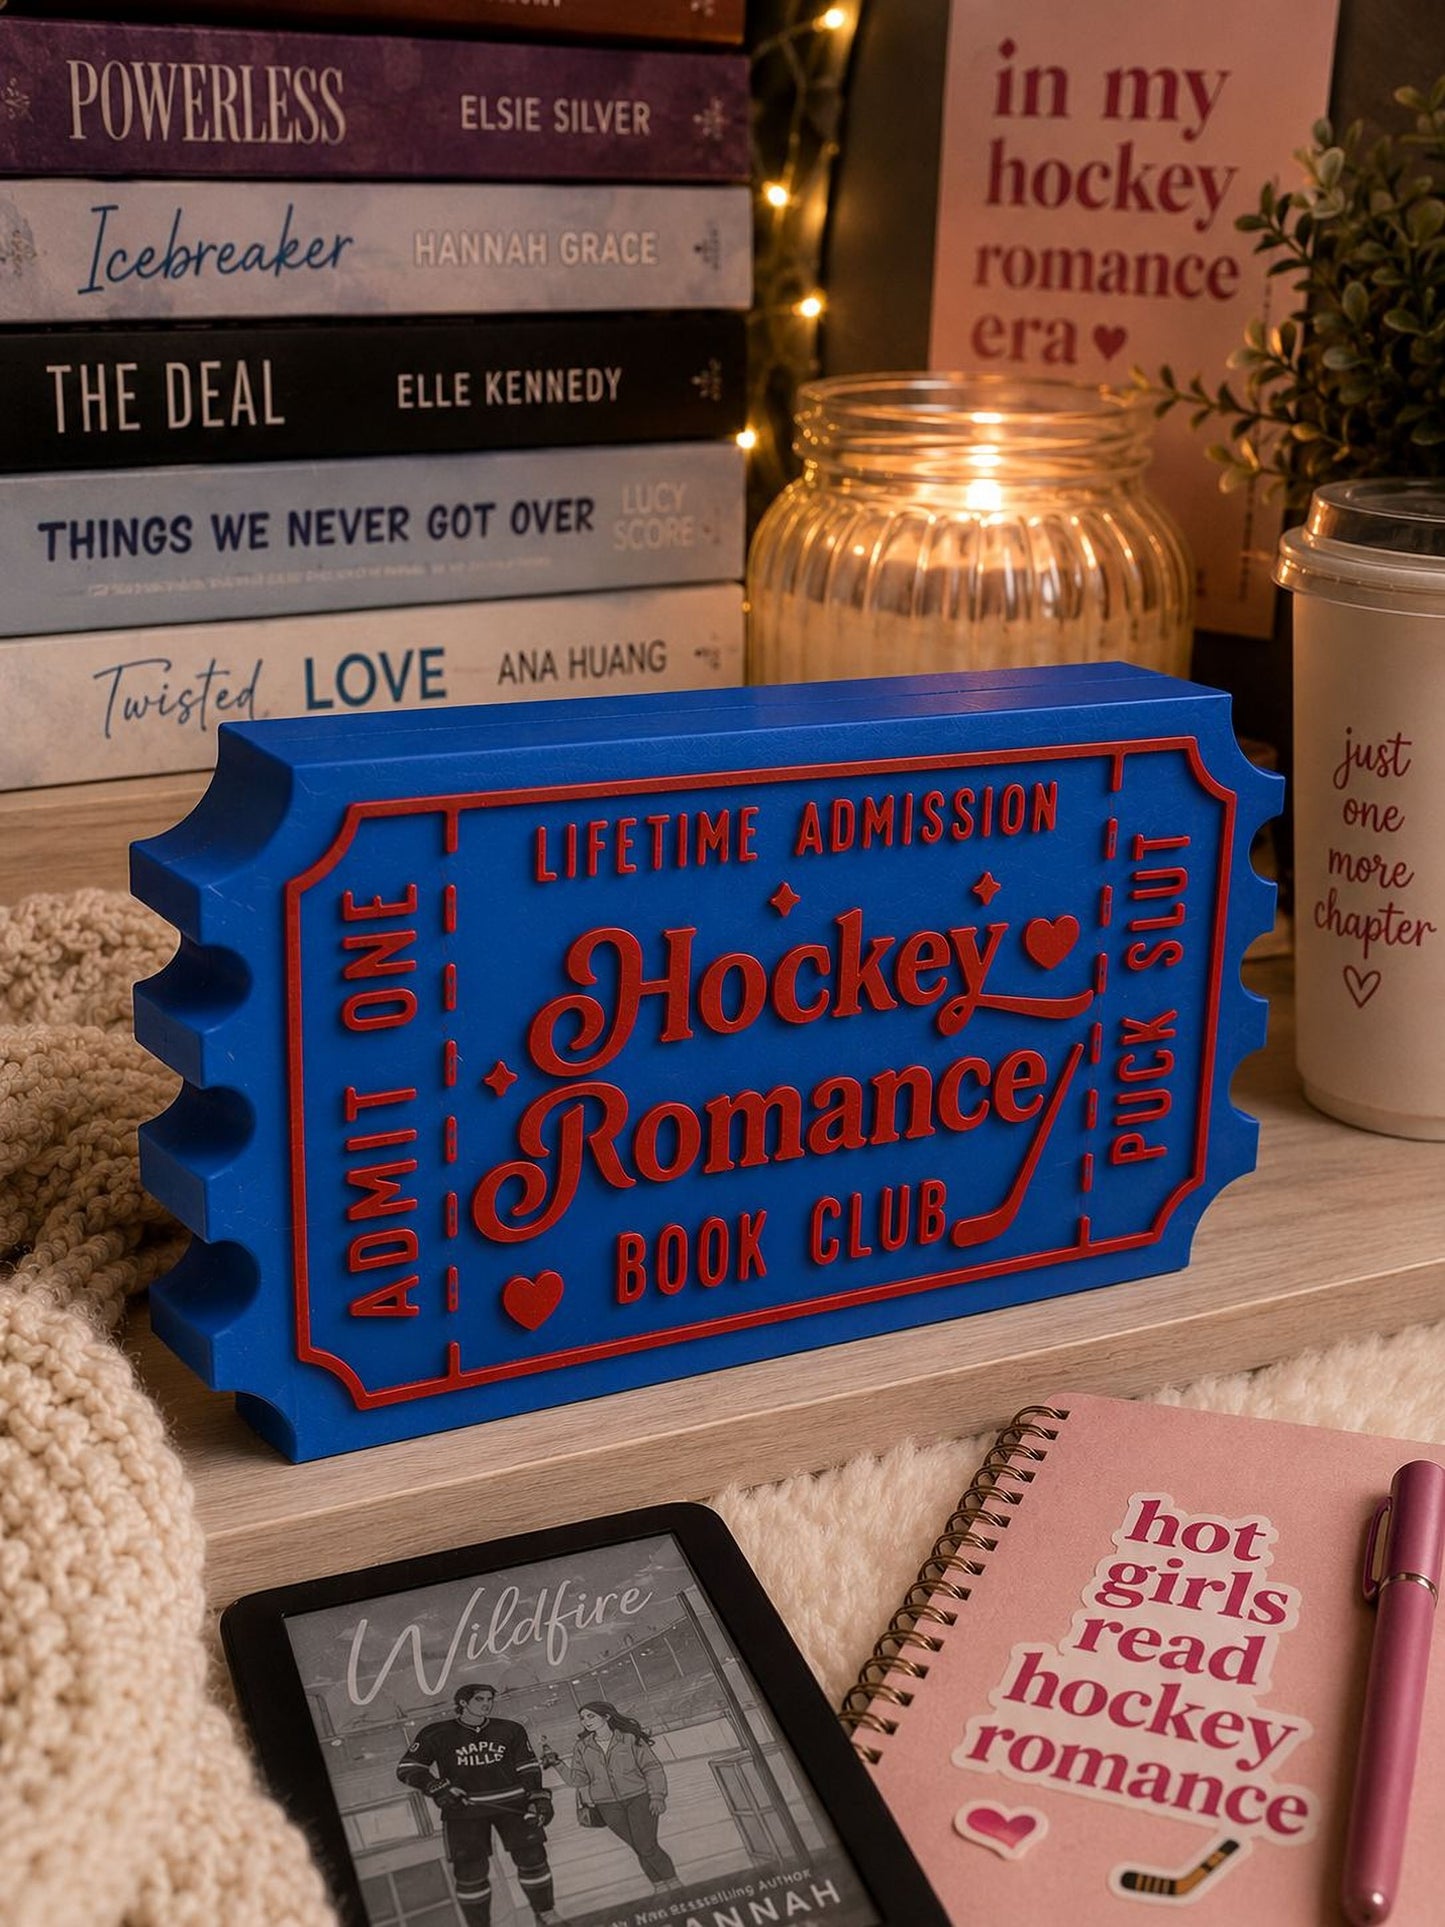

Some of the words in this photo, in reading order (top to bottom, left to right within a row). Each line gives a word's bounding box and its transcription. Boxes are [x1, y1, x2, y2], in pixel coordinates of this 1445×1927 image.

[66, 59, 346, 145] POWERLESS
[461, 95, 541, 132] ELSIE
[554, 99, 652, 136] SILVER
[993, 38, 1070, 120] in
[1102, 66, 1230, 142] my
[985, 137, 1239, 232] hockey
[78, 203, 355, 295] Icebreaker
[413, 231, 548, 267] HANNAH
[560, 230, 659, 268] GRACE
[972, 242, 1240, 300] romance
[970, 312, 1077, 366] era
[46, 362, 141, 434] THE
[164, 359, 286, 430] DEAL
[397, 372, 471, 409] ELLE
[485, 367, 623, 405] KENNEDY
[38, 514, 193, 562] THINGS
[211, 511, 269, 551] WE
[288, 505, 410, 547] NEVER
[427, 502, 496, 542] GOT
[511, 497, 594, 535] OVER
[613, 515, 695, 550] SCORE
[621, 481, 687, 514] LUCY
[93, 658, 262, 739] Twisted
[304, 647, 447, 711] LOVE
[498, 648, 559, 687] ANA
[569, 639, 668, 681] HUANG
[1333, 726, 1412, 790] just
[534, 805, 760, 883] LIFETIME
[795, 781, 1059, 856] ADMISSION
[1343, 798, 1405, 832] one
[1127, 833, 1192, 971] SLUT
[1328, 848, 1414, 888] more
[341, 883, 419, 1032] ONE
[1314, 887, 1437, 959] chapter
[528, 907, 1095, 1078] Hockey
[1110, 1009, 1178, 1165] PUCK
[471, 1048, 1048, 1243] Romance
[345, 1085, 420, 1318] ADMIT
[616, 1209, 767, 1304] BOOK
[810, 1179, 948, 1266] CLUB
[1124, 1499, 1266, 1561] hot
[1094, 1558, 1288, 1625] girls
[346, 1579, 654, 1705] Wildfire
[1072, 1618, 1266, 1685] read
[455, 1741, 506, 1757] MAPLE
[1002, 1652, 1299, 1772] hockey
[966, 1725, 1309, 1835] romance
